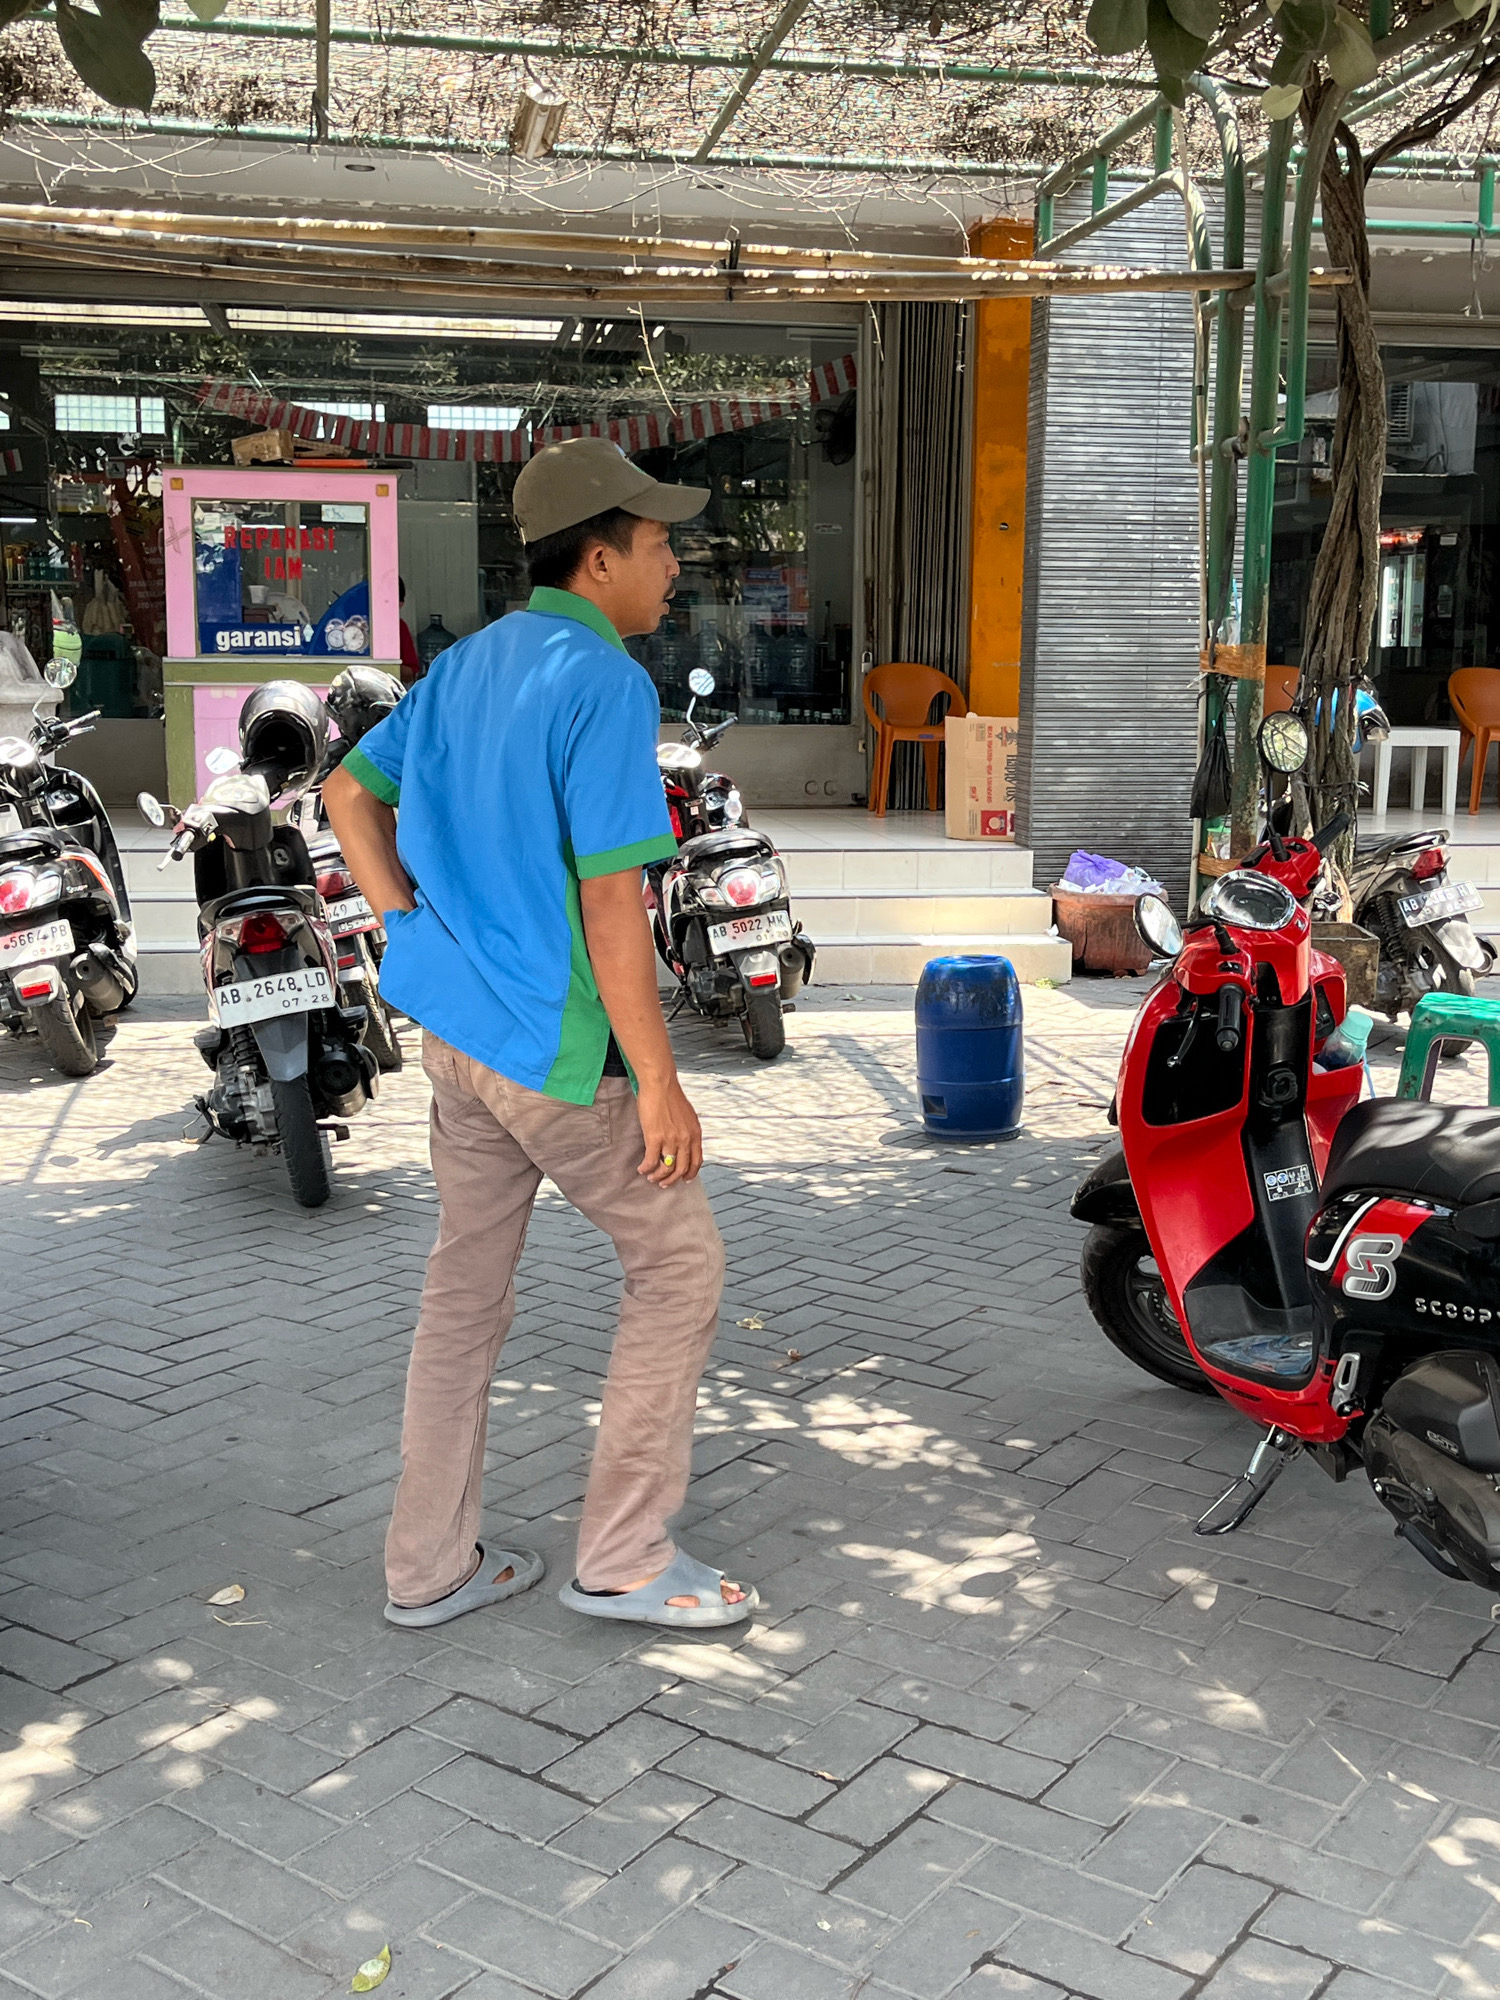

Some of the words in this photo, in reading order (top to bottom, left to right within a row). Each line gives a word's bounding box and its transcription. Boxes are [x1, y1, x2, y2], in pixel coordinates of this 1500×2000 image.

[224, 526, 334, 550] REPARASI
[216, 626, 301, 652] garansi
[1402, 899, 1419, 912] AB
[10, 930, 46, 949] 5664
[50, 925, 67, 938] PB
[713, 926, 727, 939] AB
[732, 919, 762, 934] 5022
[767, 914, 786, 927] MK
[220, 988, 241, 1007] AB
[253, 977, 297, 999] 2648
[305, 972, 326, 988] LD
[1415, 1297, 1500, 1324] SCOOP
